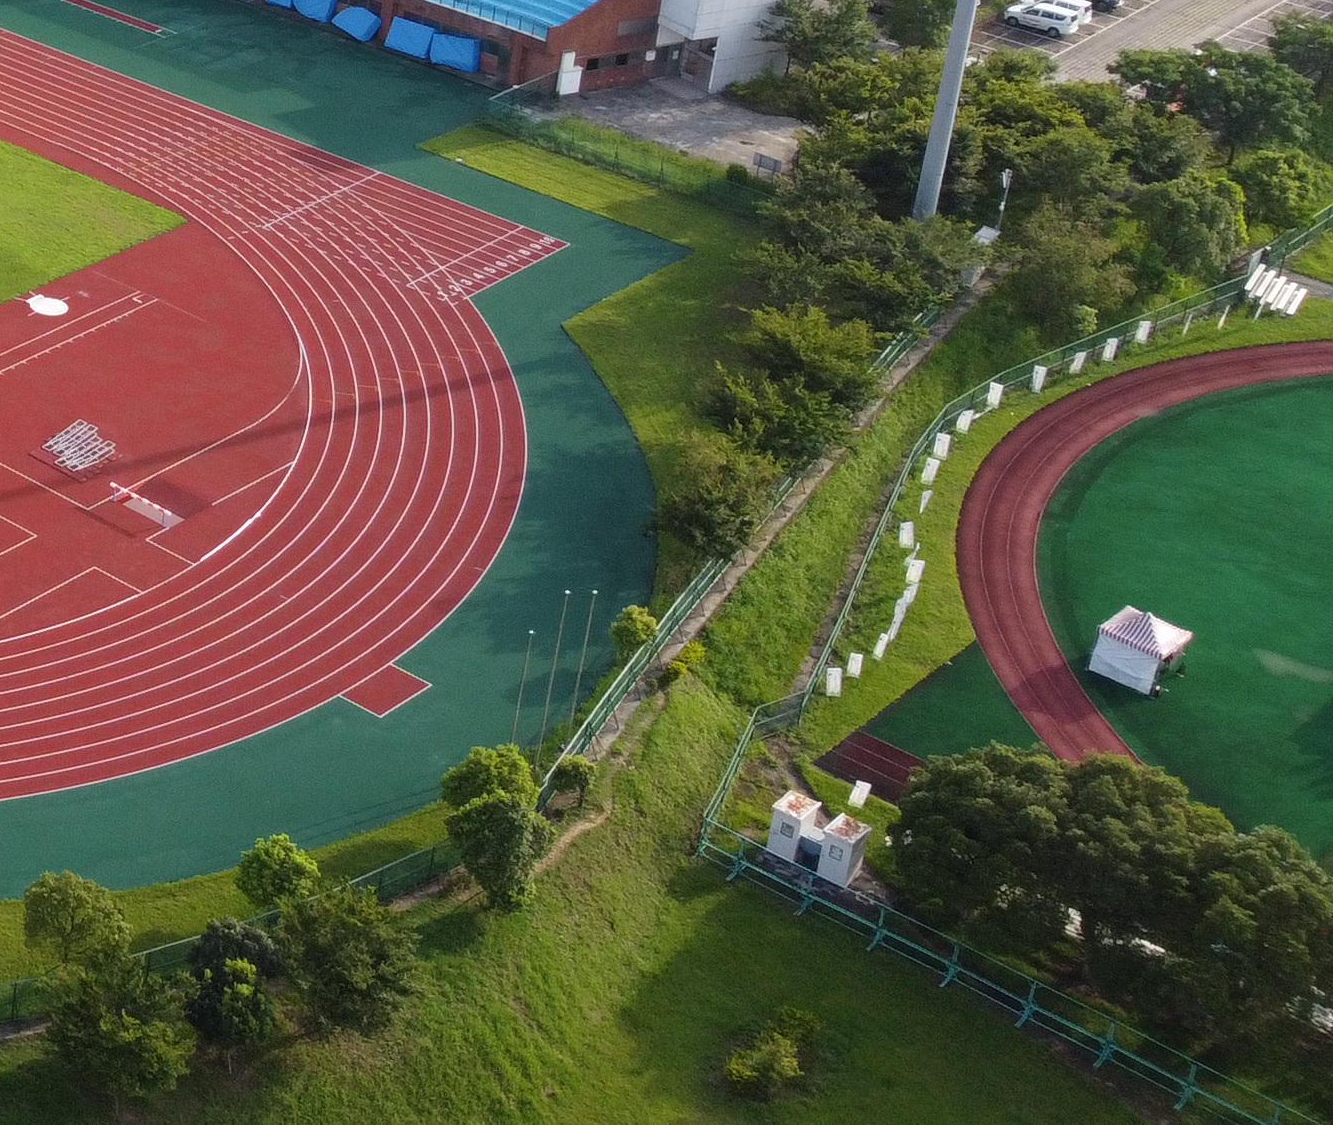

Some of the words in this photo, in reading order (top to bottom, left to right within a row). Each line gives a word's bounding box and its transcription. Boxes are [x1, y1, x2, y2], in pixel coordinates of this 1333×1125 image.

[460, 278, 473, 286] 3
[472, 272, 486, 280] 4
[483, 266, 497, 274] 5
[495, 260, 508, 268] 6
[505, 254, 520, 262] 7
[517, 248, 532, 256] 8
